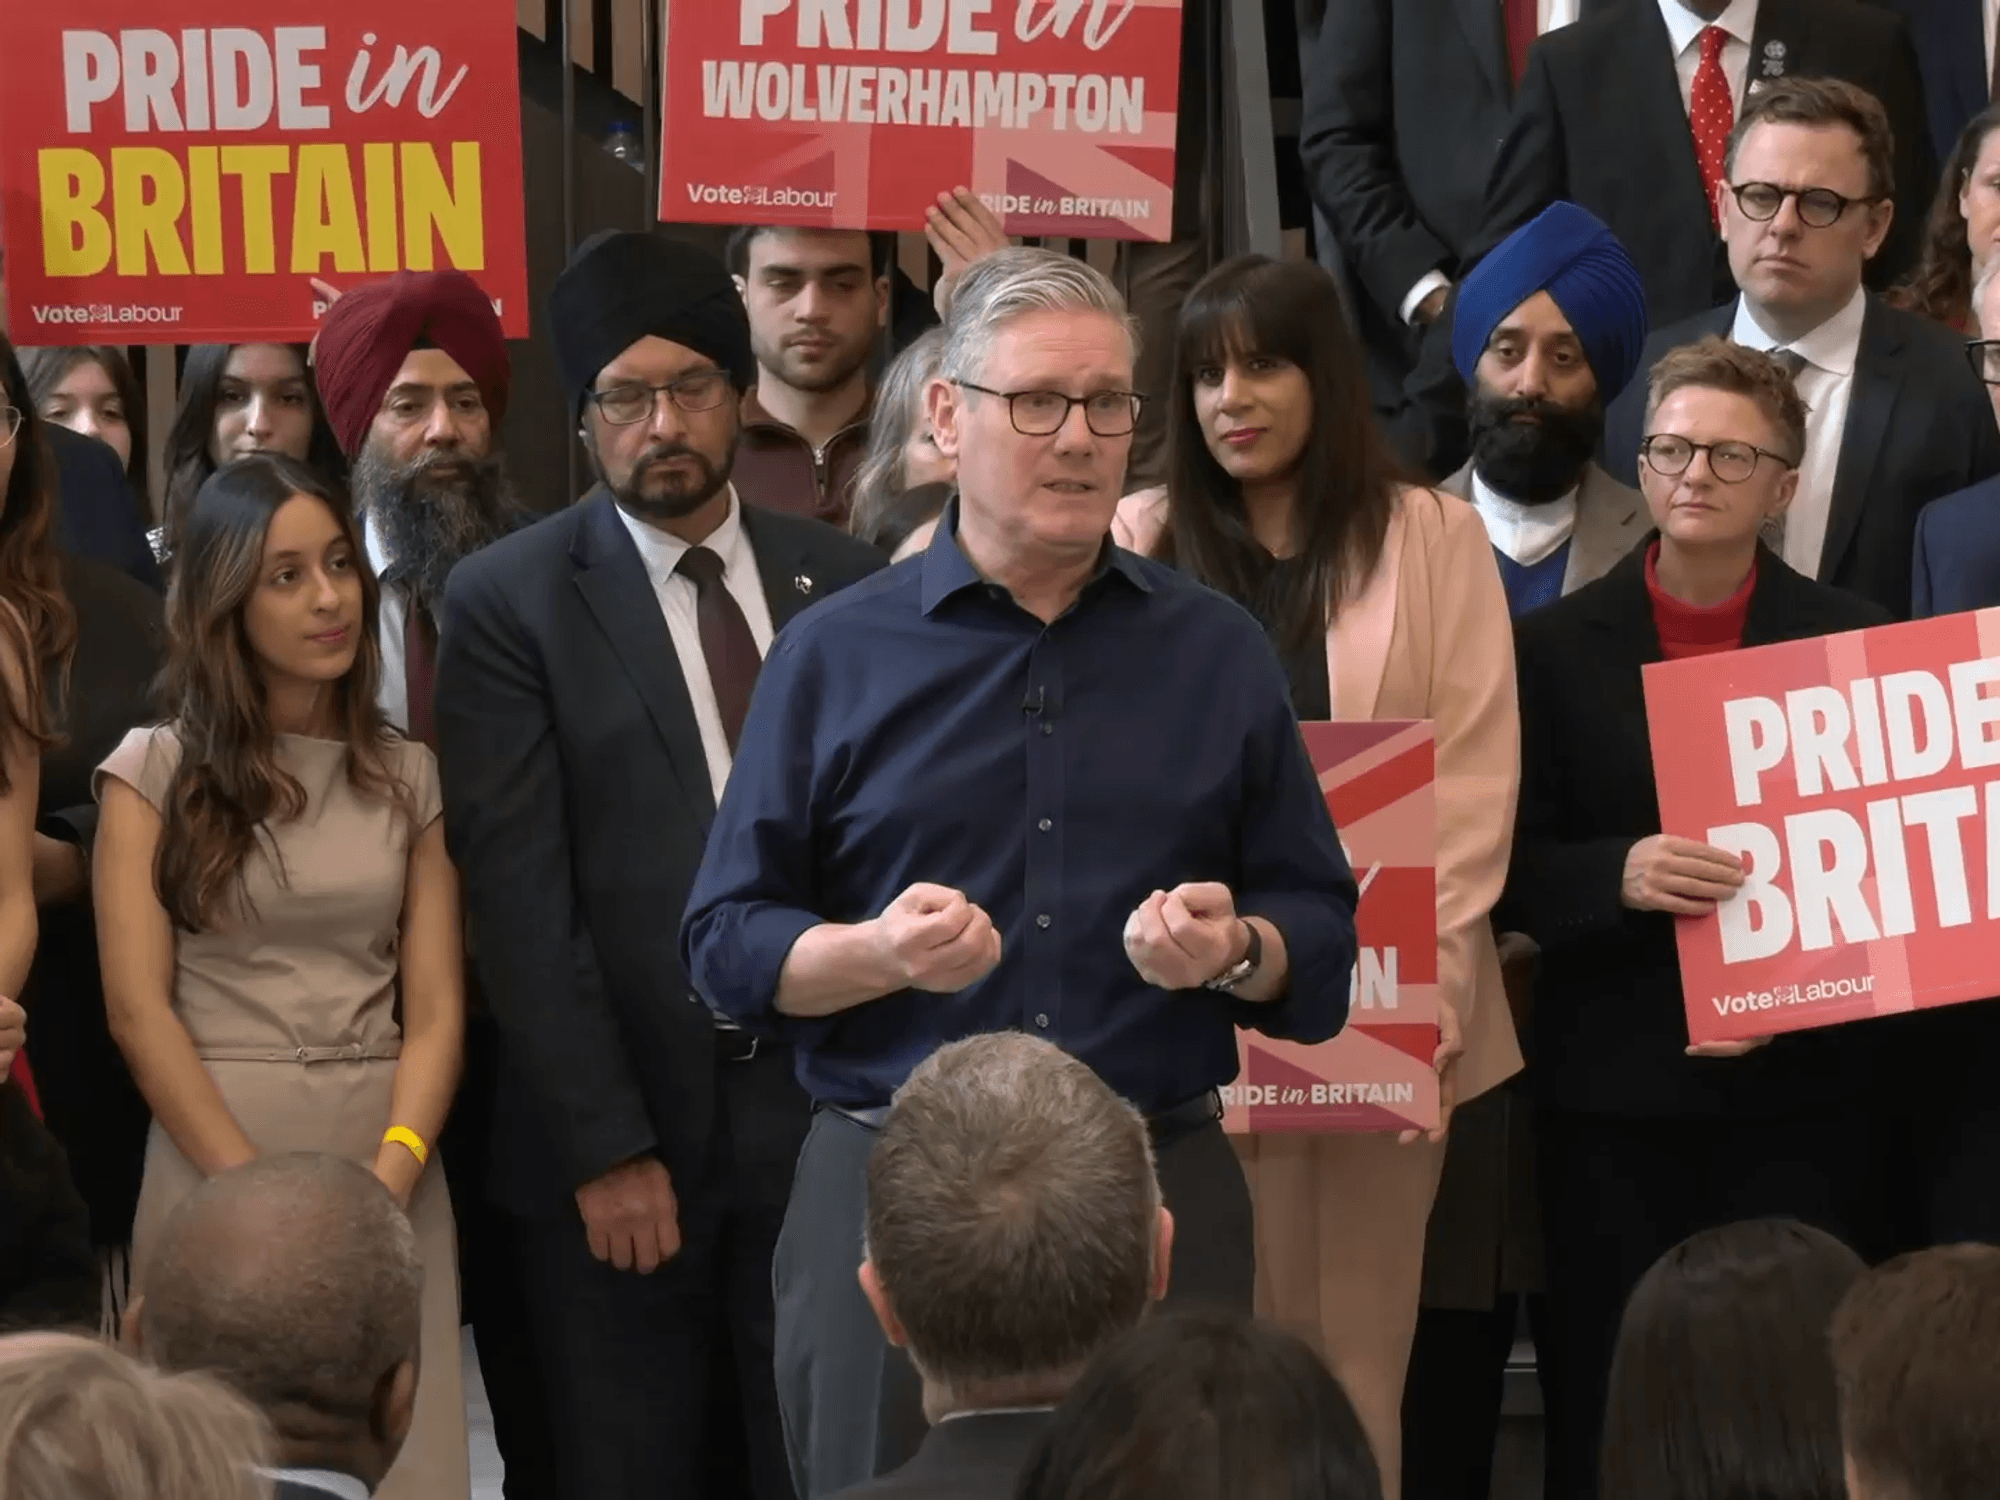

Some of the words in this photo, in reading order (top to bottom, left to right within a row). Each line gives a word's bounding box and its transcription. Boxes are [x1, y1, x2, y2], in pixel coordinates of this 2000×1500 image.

[63, 26, 330, 133] PRIDE
[346, 32, 468, 118] in
[702, 60, 1145, 134] WOLVERHAMPTON
[38, 141, 484, 277] BRITAIN
[686, 182, 743, 204] Vote
[763, 187, 837, 207] Labour
[979, 193, 1031, 213] RIDE
[1033, 196, 1059, 215] in
[1060, 197, 1150, 218] BRITAIN
[31, 304, 89, 323] Vote
[108, 304, 183, 322] Labour
[1724, 655, 2000, 807] PRIDE
[1706, 780, 2000, 965] BRIT
[1712, 991, 1774, 1016] Vote
[1794, 974, 1876, 1003] Labour
[1217, 1084, 1278, 1105] RIDE
[1280, 1085, 1309, 1105] in
[1311, 1082, 1414, 1104] BRITAIN
